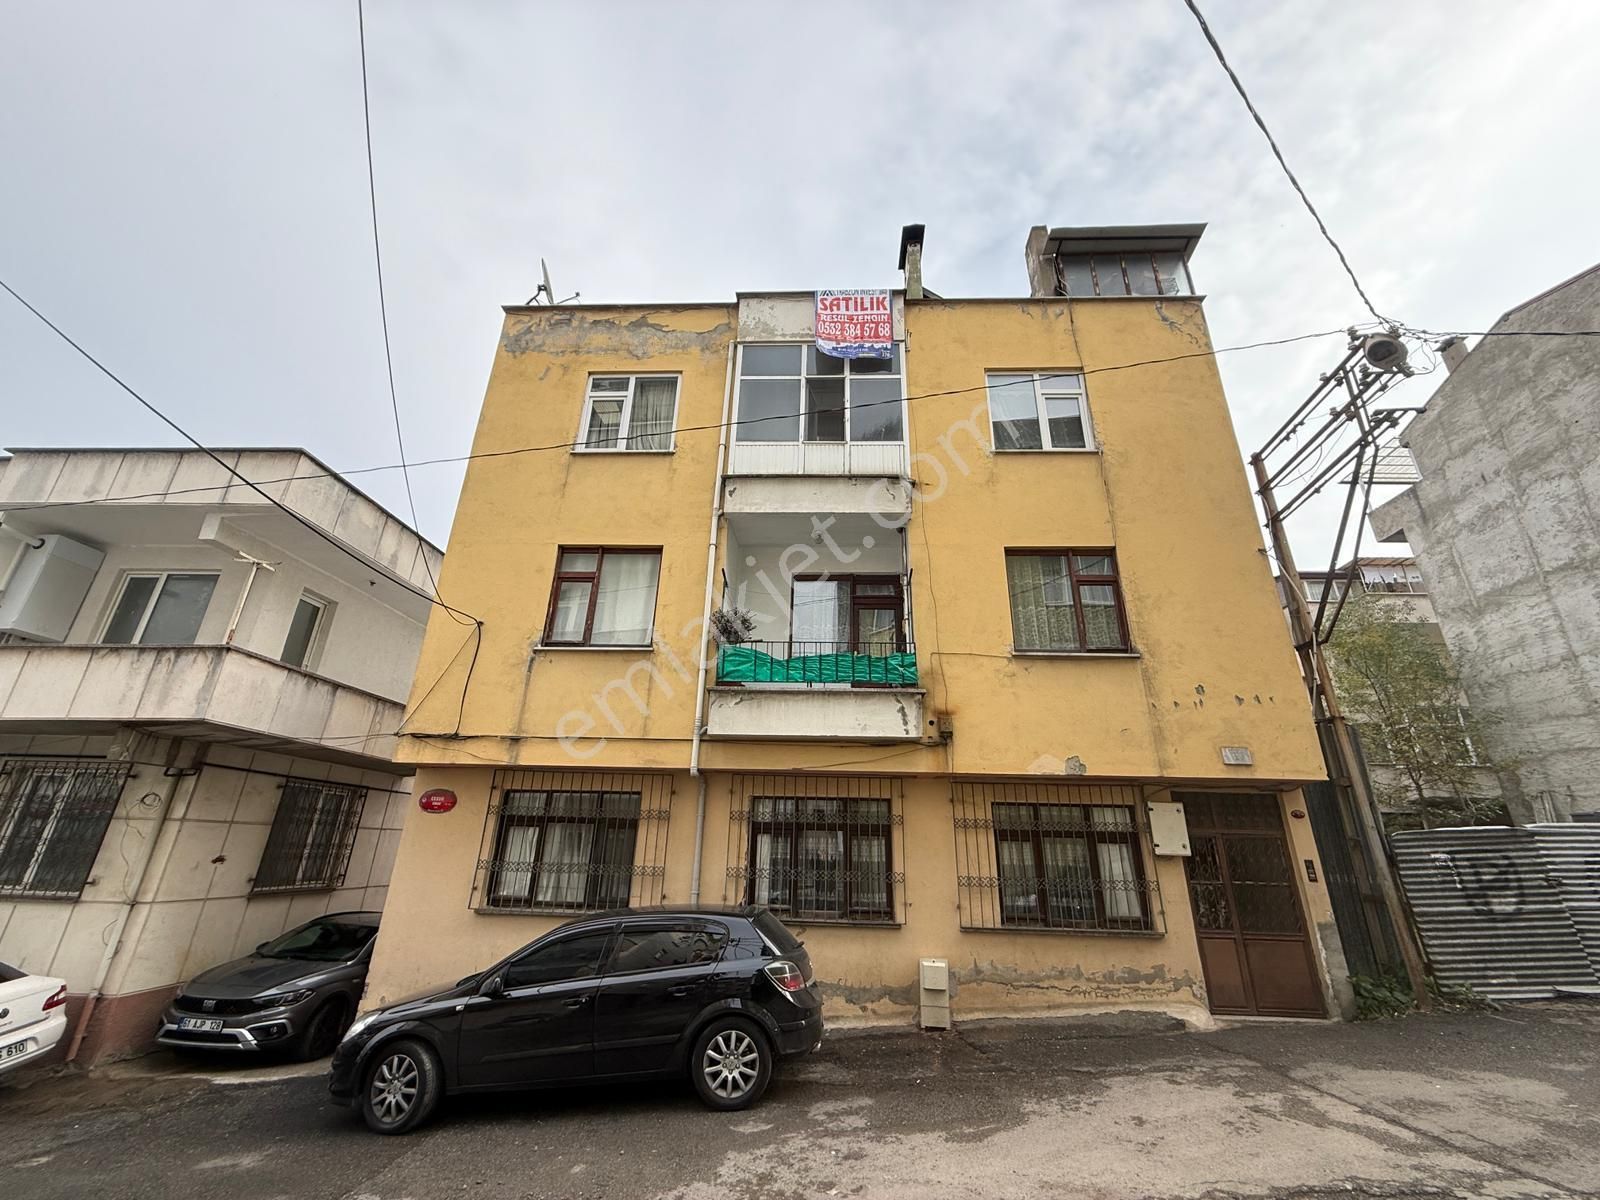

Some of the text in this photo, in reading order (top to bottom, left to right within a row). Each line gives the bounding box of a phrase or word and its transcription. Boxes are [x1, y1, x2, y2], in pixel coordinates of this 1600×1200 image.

[819, 296, 888, 312] SATILIK
[818, 322, 841, 334] 0532
[864, 323, 876, 337] 57
[878, 323, 890, 337] 68
[6, 1042, 25, 1057] 610
